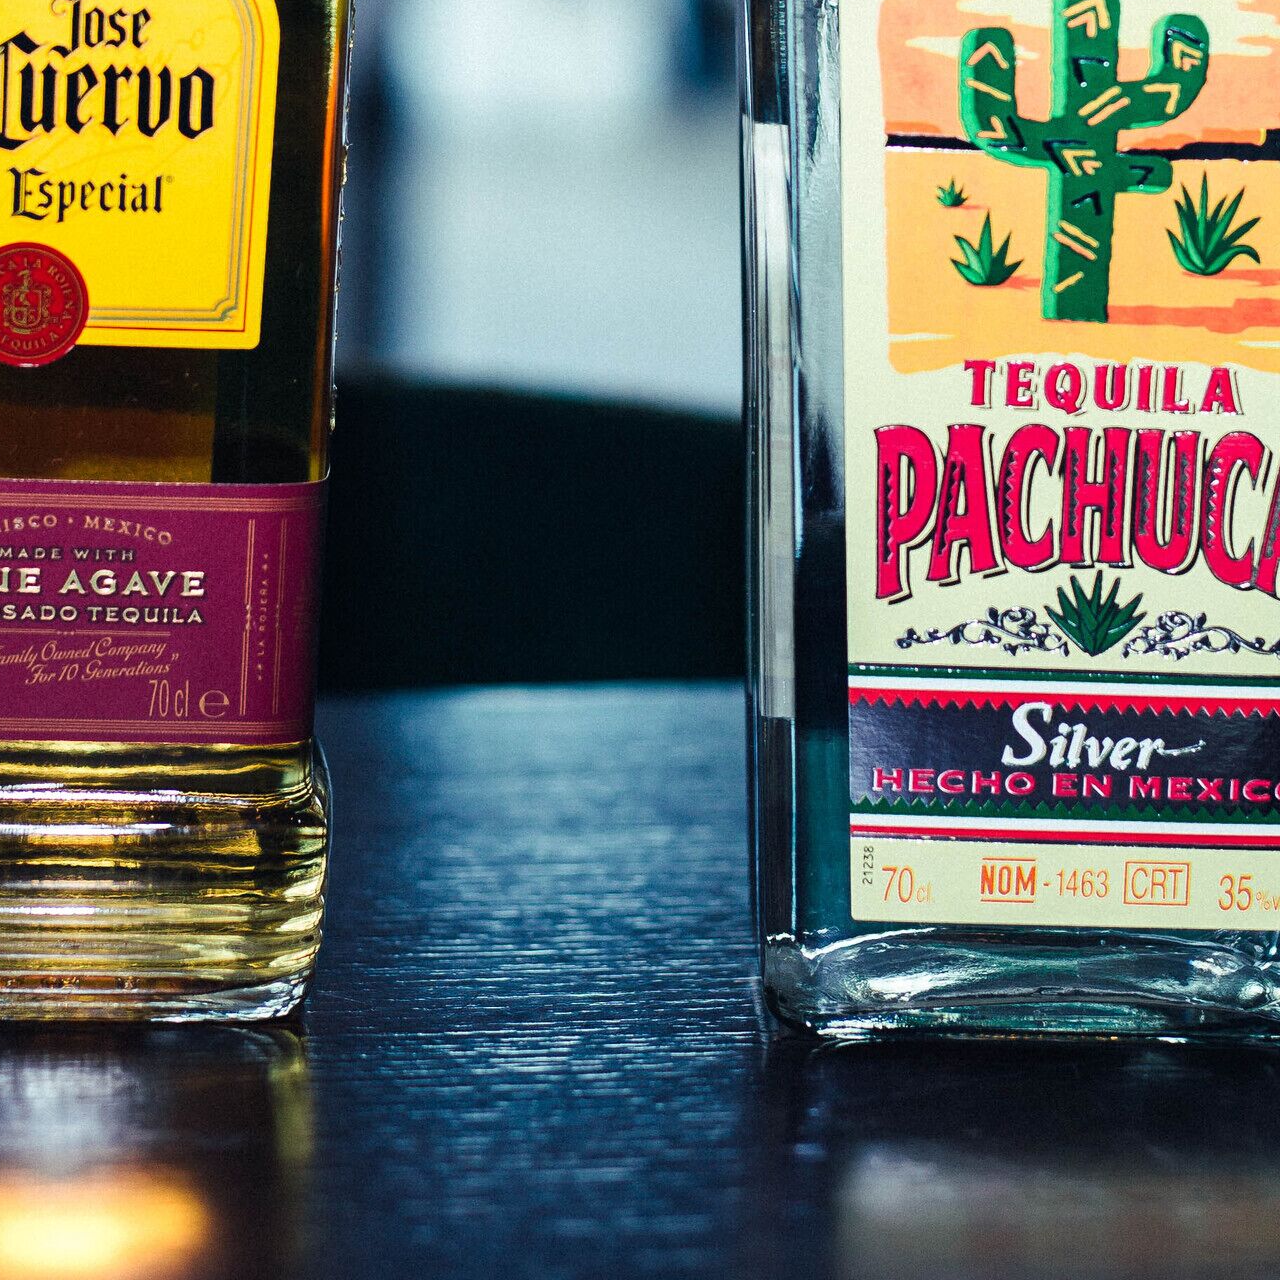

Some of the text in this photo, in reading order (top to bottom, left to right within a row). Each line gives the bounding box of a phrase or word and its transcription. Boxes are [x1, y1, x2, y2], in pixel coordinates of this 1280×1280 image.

[7, 167, 164, 223] Especial
[963, 359, 1245, 416] TEQUILA
[83, 515, 172, 545] MEXICO
[74, 548, 135, 561] WITH
[58, 569, 206, 597] AGAVE
[87, 606, 204, 624] TEQUILA
[41, 639, 96, 662] Owned
[95, 636, 168, 662] Company
[25, 663, 56, 685] For
[58, 663, 80, 682] 10
[149, 679, 170, 717] 70
[174, 679, 190, 717] cl
[1000, 700, 1207, 770] Silver
[872, 767, 1036, 797] HECHO
[1052, 772, 1113, 799] EN
[861, 844, 875, 885] 21238
[979, 862, 1037, 897] NOM
[1130, 866, 1184, 901] CRT
